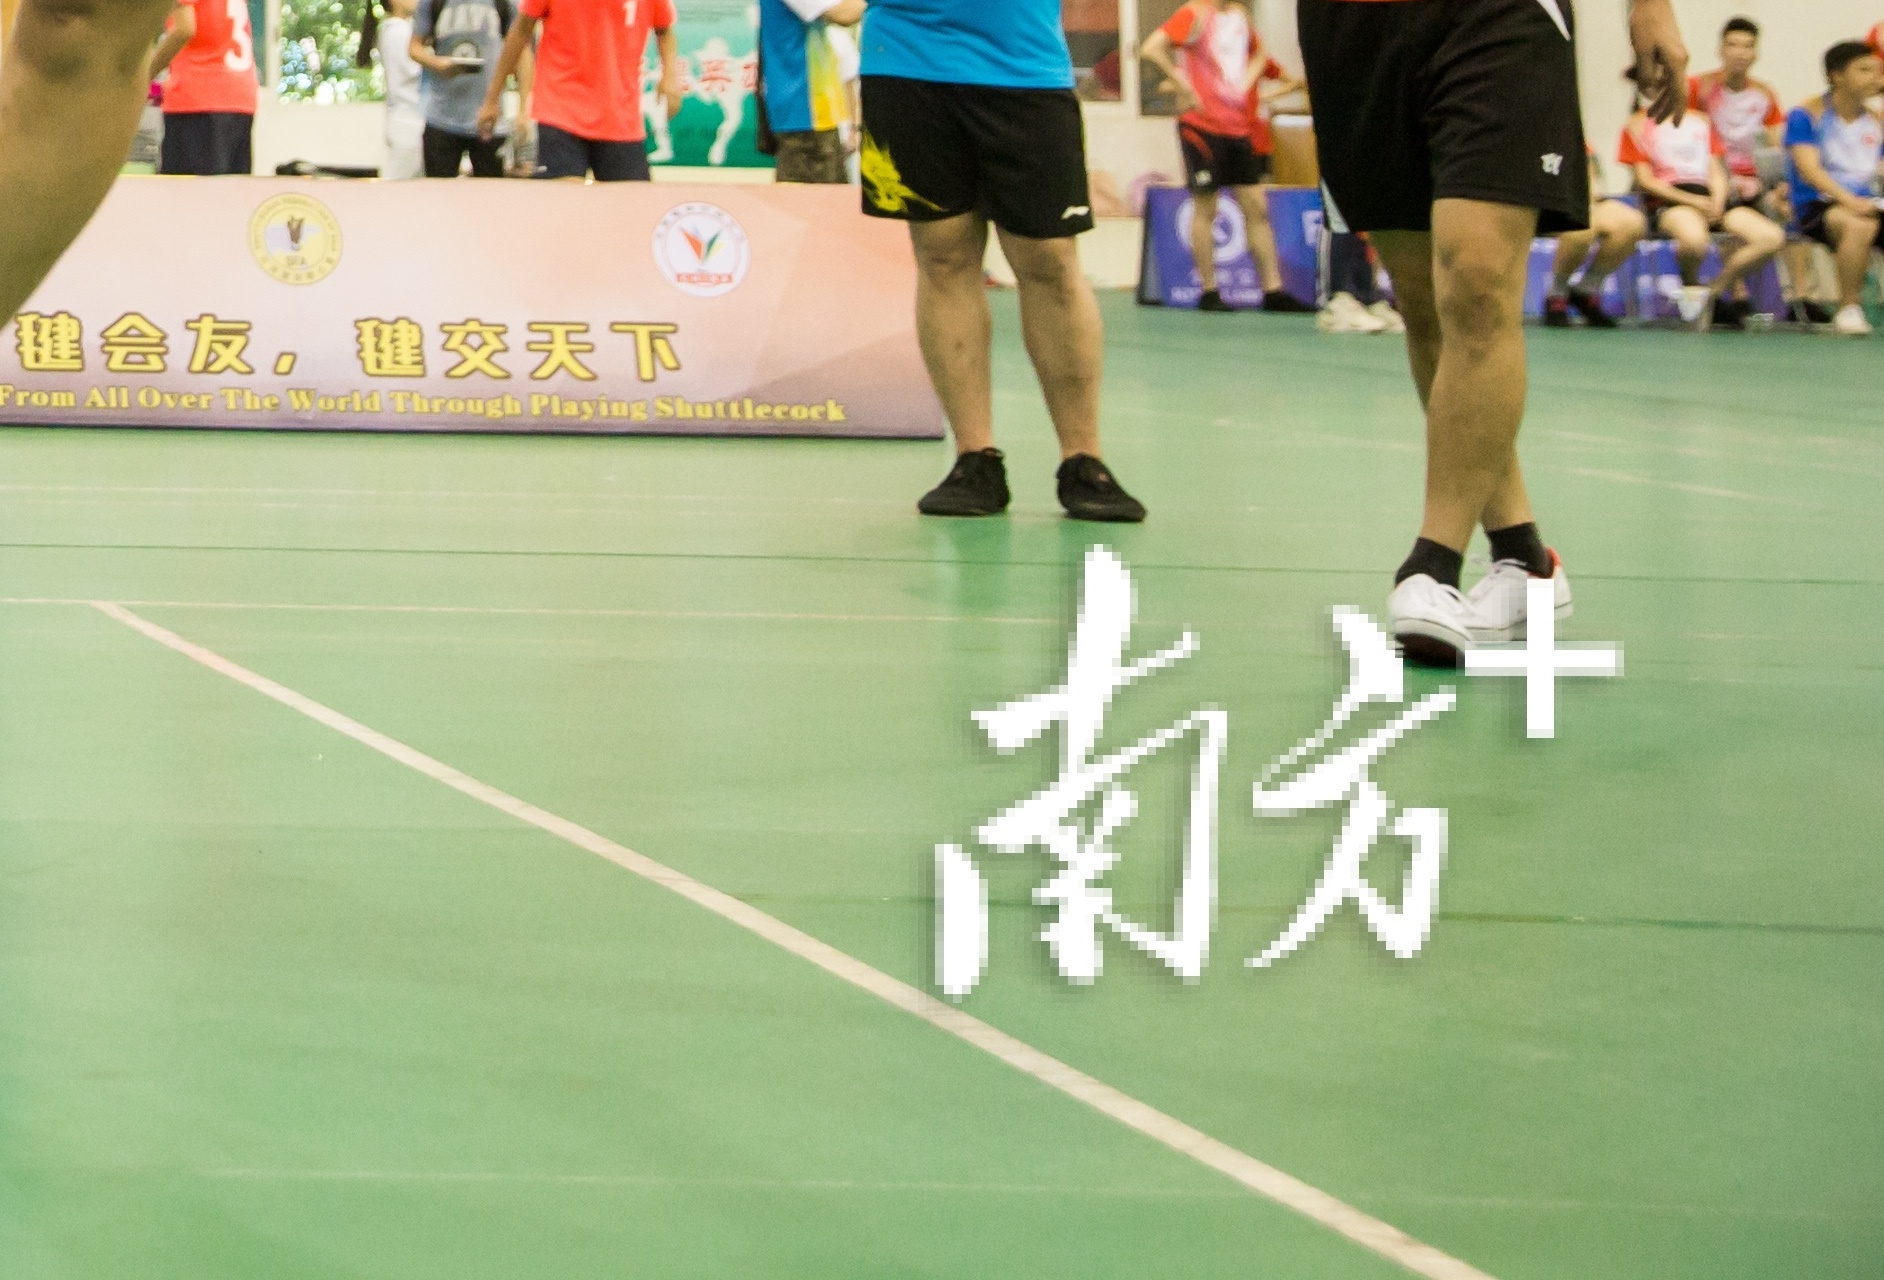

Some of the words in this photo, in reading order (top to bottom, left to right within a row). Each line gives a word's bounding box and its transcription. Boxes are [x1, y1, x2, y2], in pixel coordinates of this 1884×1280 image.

[85, 386, 129, 409] All
[138, 386, 214, 410] Over
[221, 387, 279, 411] The
[286, 388, 381, 413] World
[388, 391, 522, 419] Through
[530, 393, 648, 421] Playing
[654, 396, 847, 422] Shuttlecock
